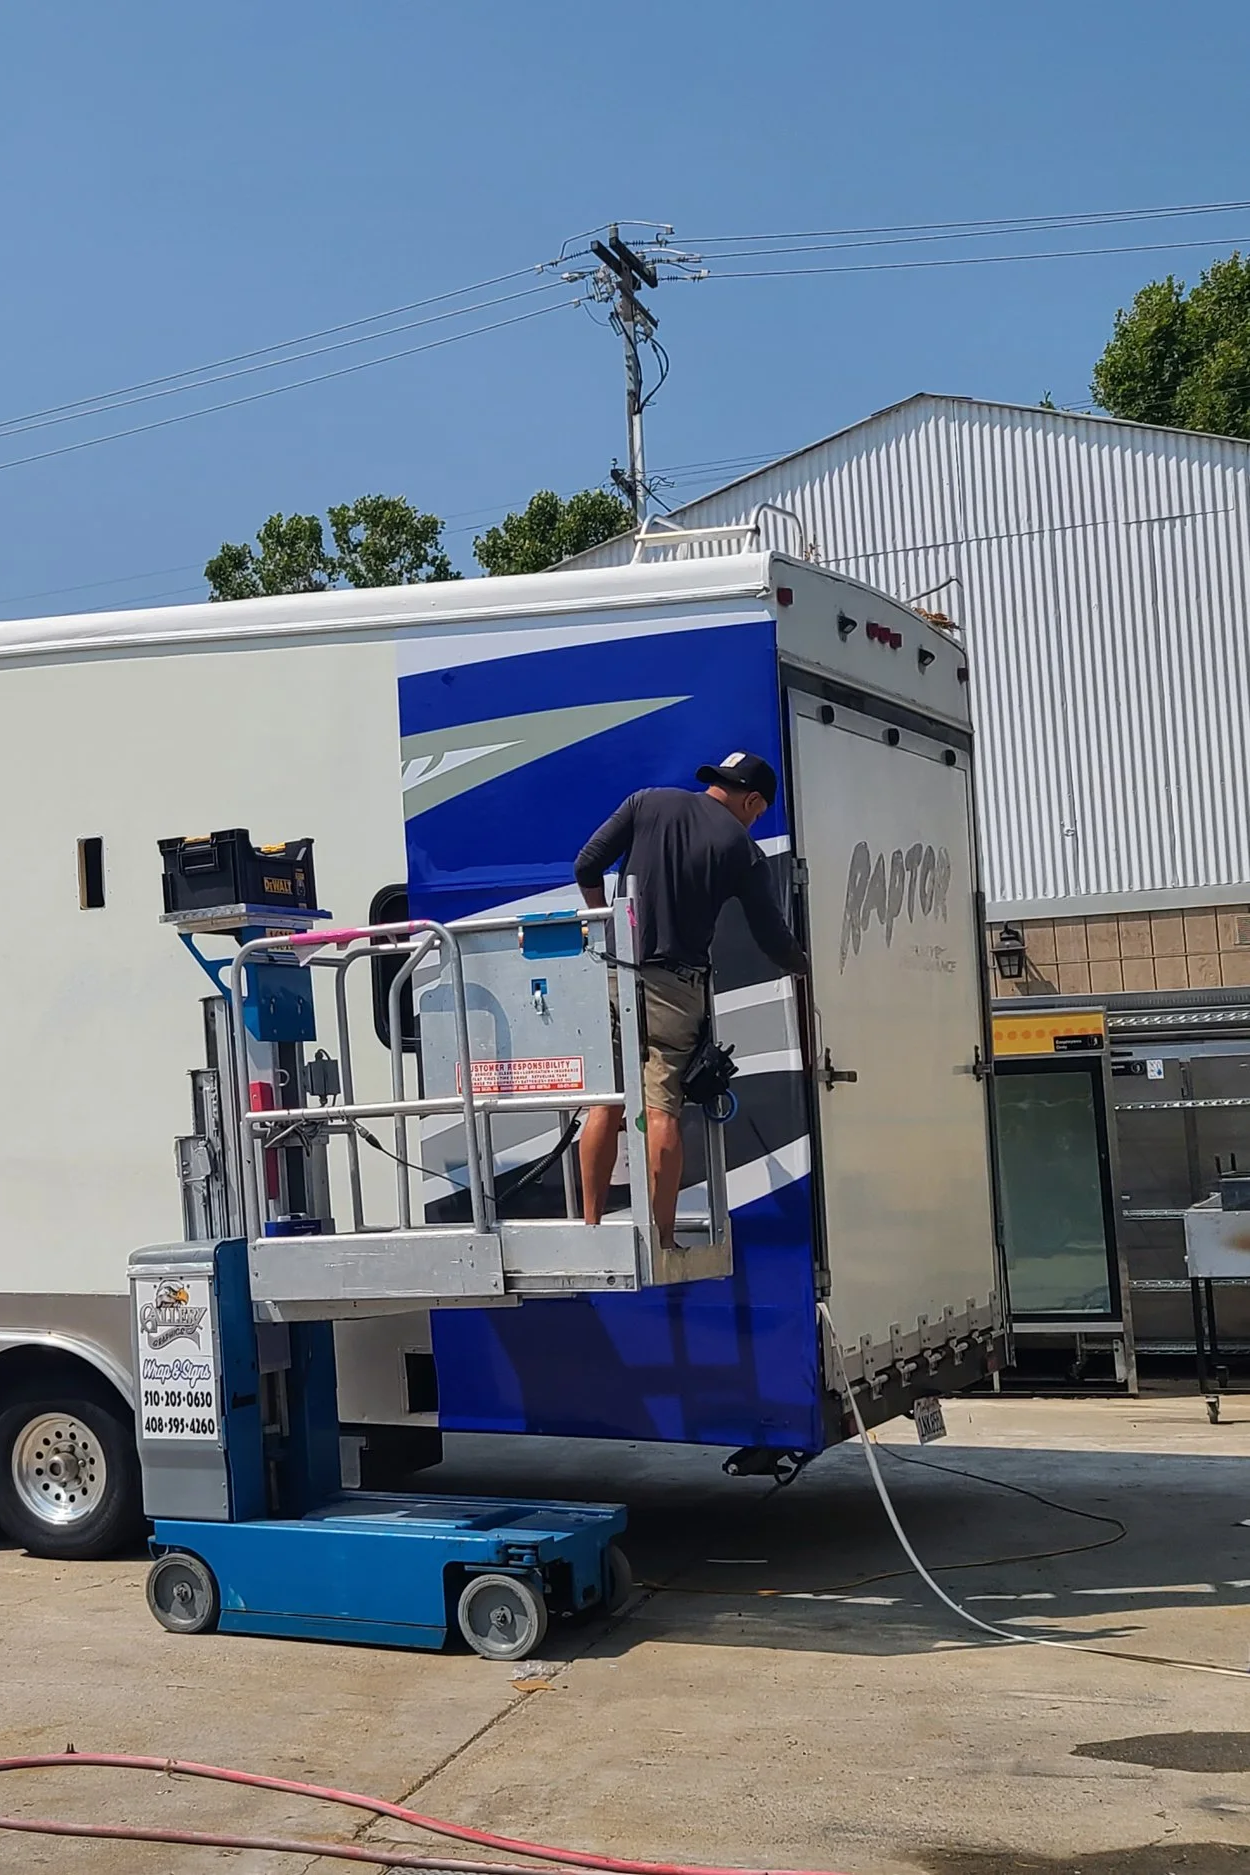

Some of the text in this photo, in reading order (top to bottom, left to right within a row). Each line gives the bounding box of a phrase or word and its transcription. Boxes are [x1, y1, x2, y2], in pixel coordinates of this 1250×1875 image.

[839, 840, 951, 976] RAPTOR
[471, 1060, 570, 1073] USTOMER RESPONSIBILITY
[140, 1303, 207, 1334] GALLERY
[152, 1327, 187, 1347] GRAPHICS
[143, 1358, 211, 1389] Wrap & Signs
